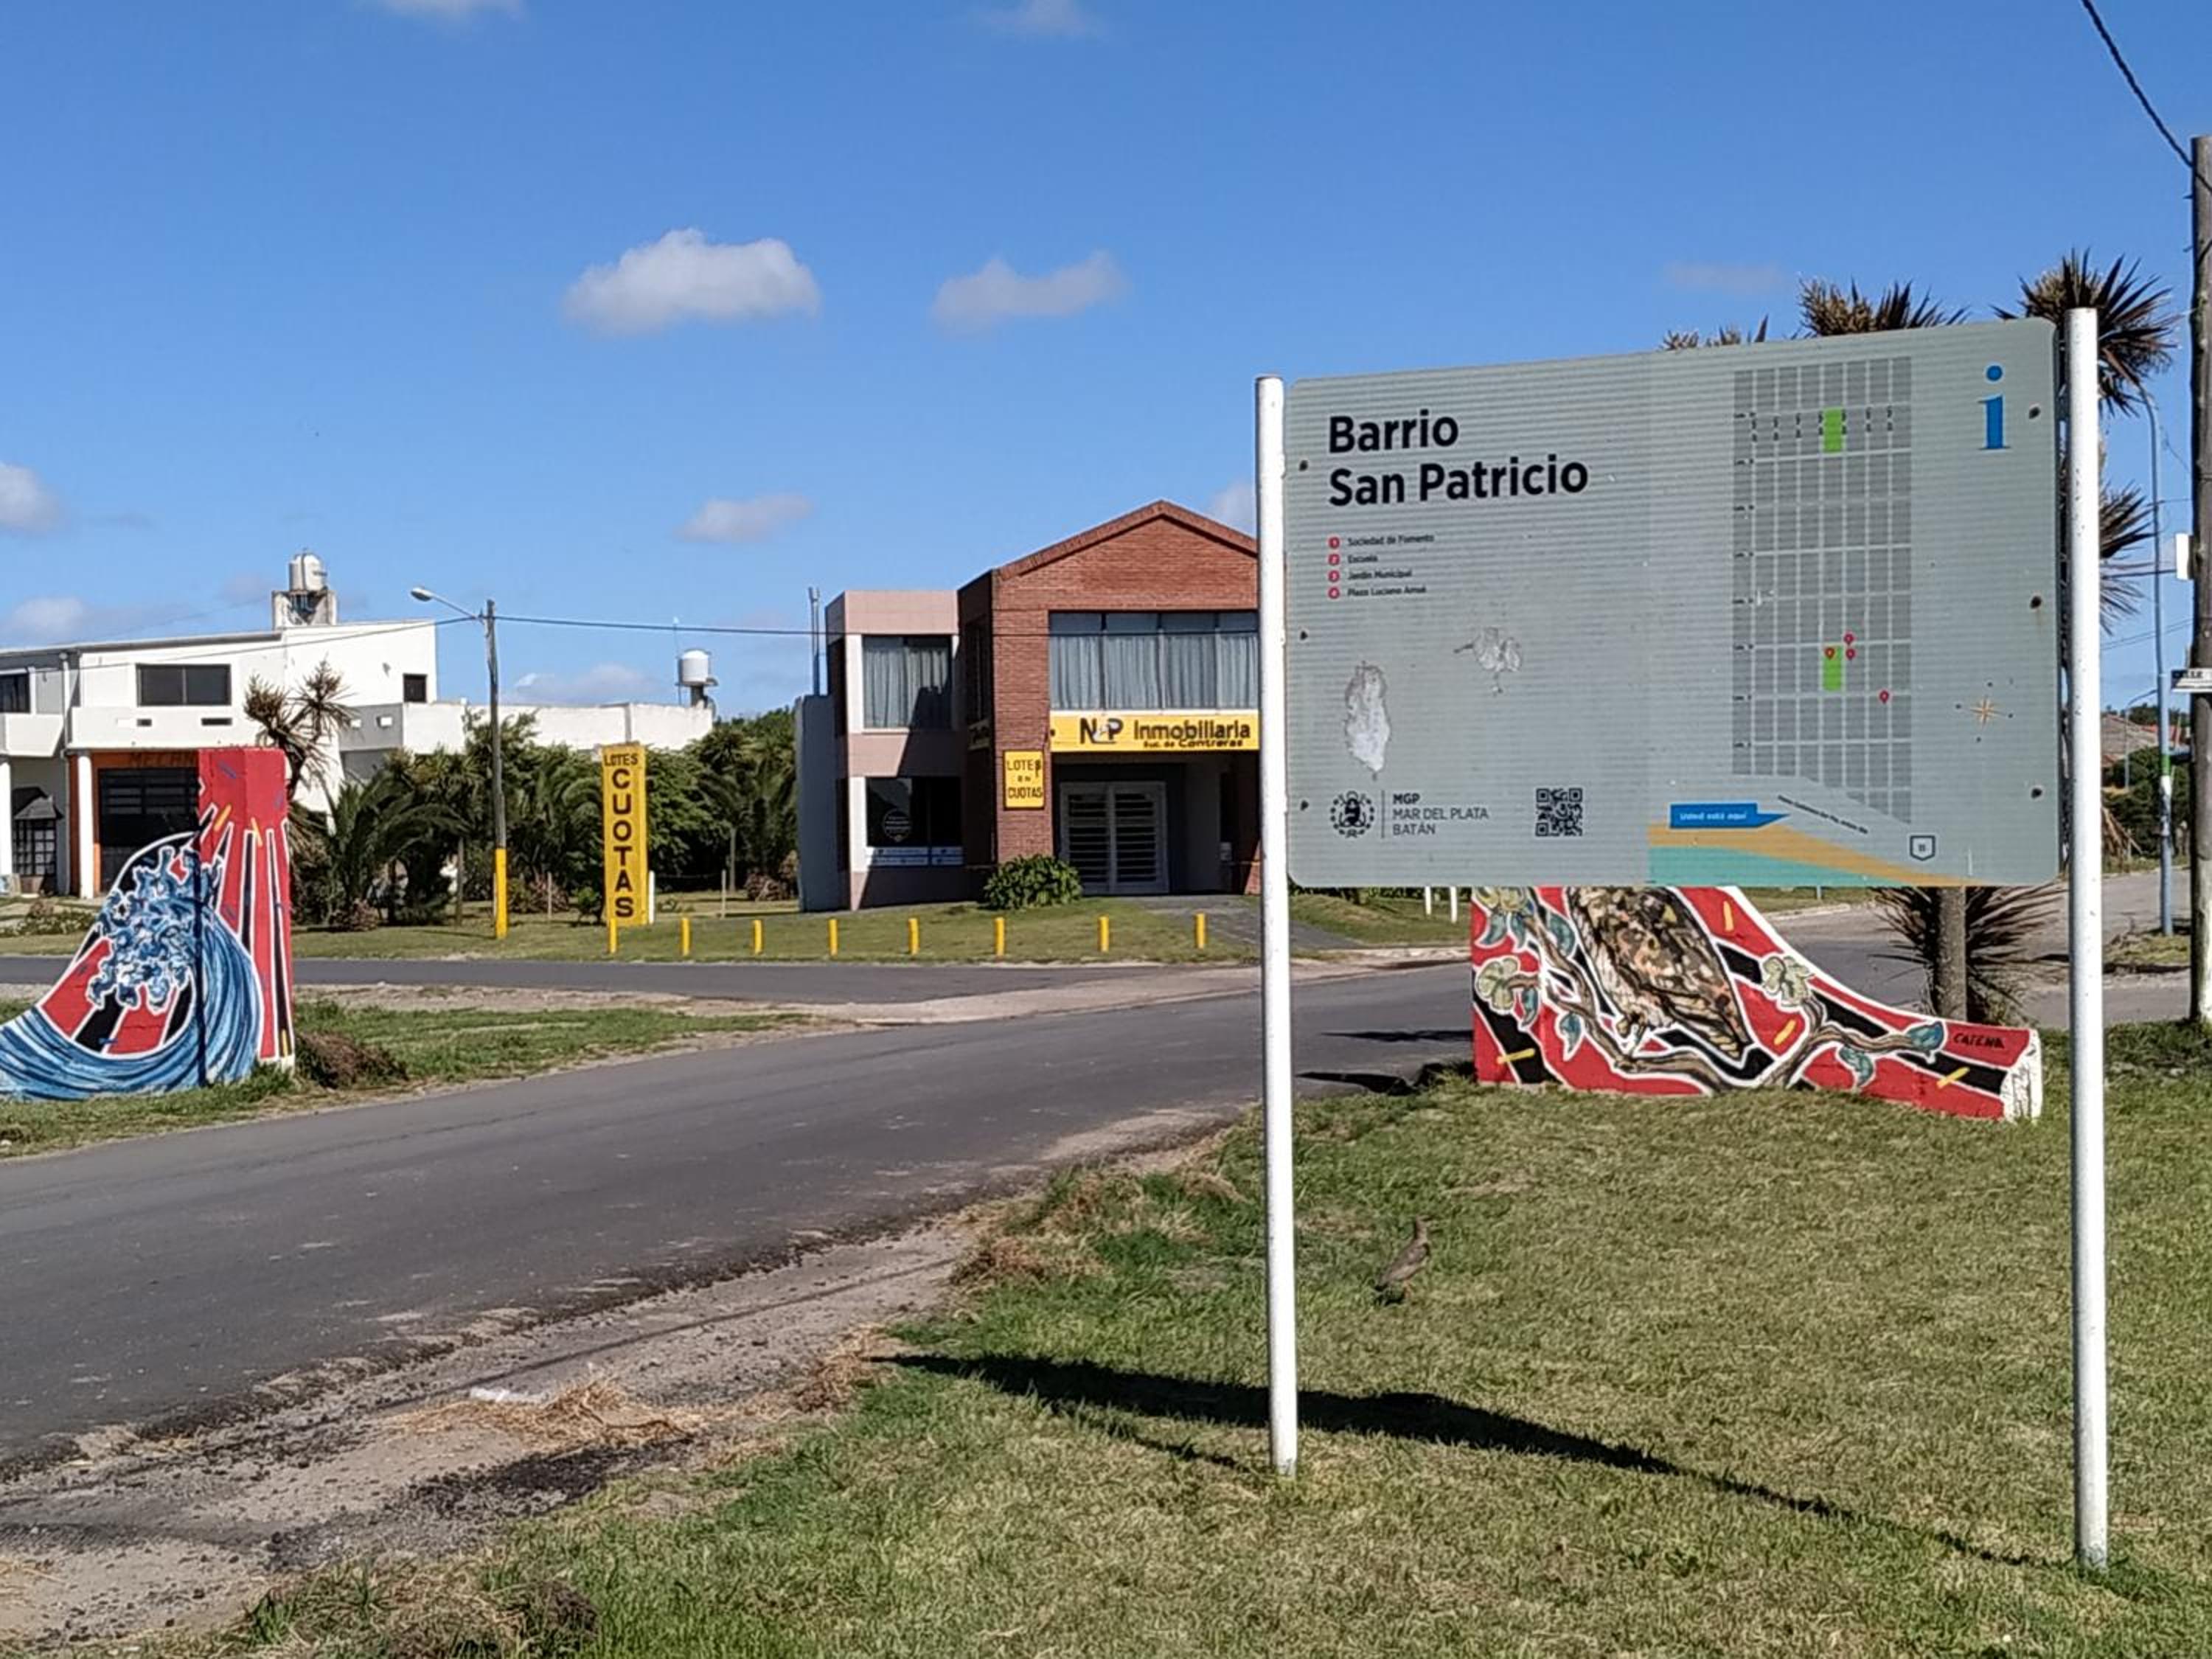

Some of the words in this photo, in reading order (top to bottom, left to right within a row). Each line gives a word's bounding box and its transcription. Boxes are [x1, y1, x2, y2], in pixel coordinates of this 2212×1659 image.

[1329, 409, 1458, 453] Barrio
[1329, 468, 1405, 507] San
[1419, 453, 1588, 501] Patricio
[1134, 720, 1251, 740] Inmobiliaria
[604, 753, 639, 767] LOTES
[1008, 787, 1043, 799] CUOTAS
[1393, 793, 1420, 804] MGP
[1393, 808, 1420, 820] MAR
[1423, 808, 1447, 820] DEL
[1450, 807, 1489, 819] PLATA
[612, 768, 634, 918] CUOTAS
